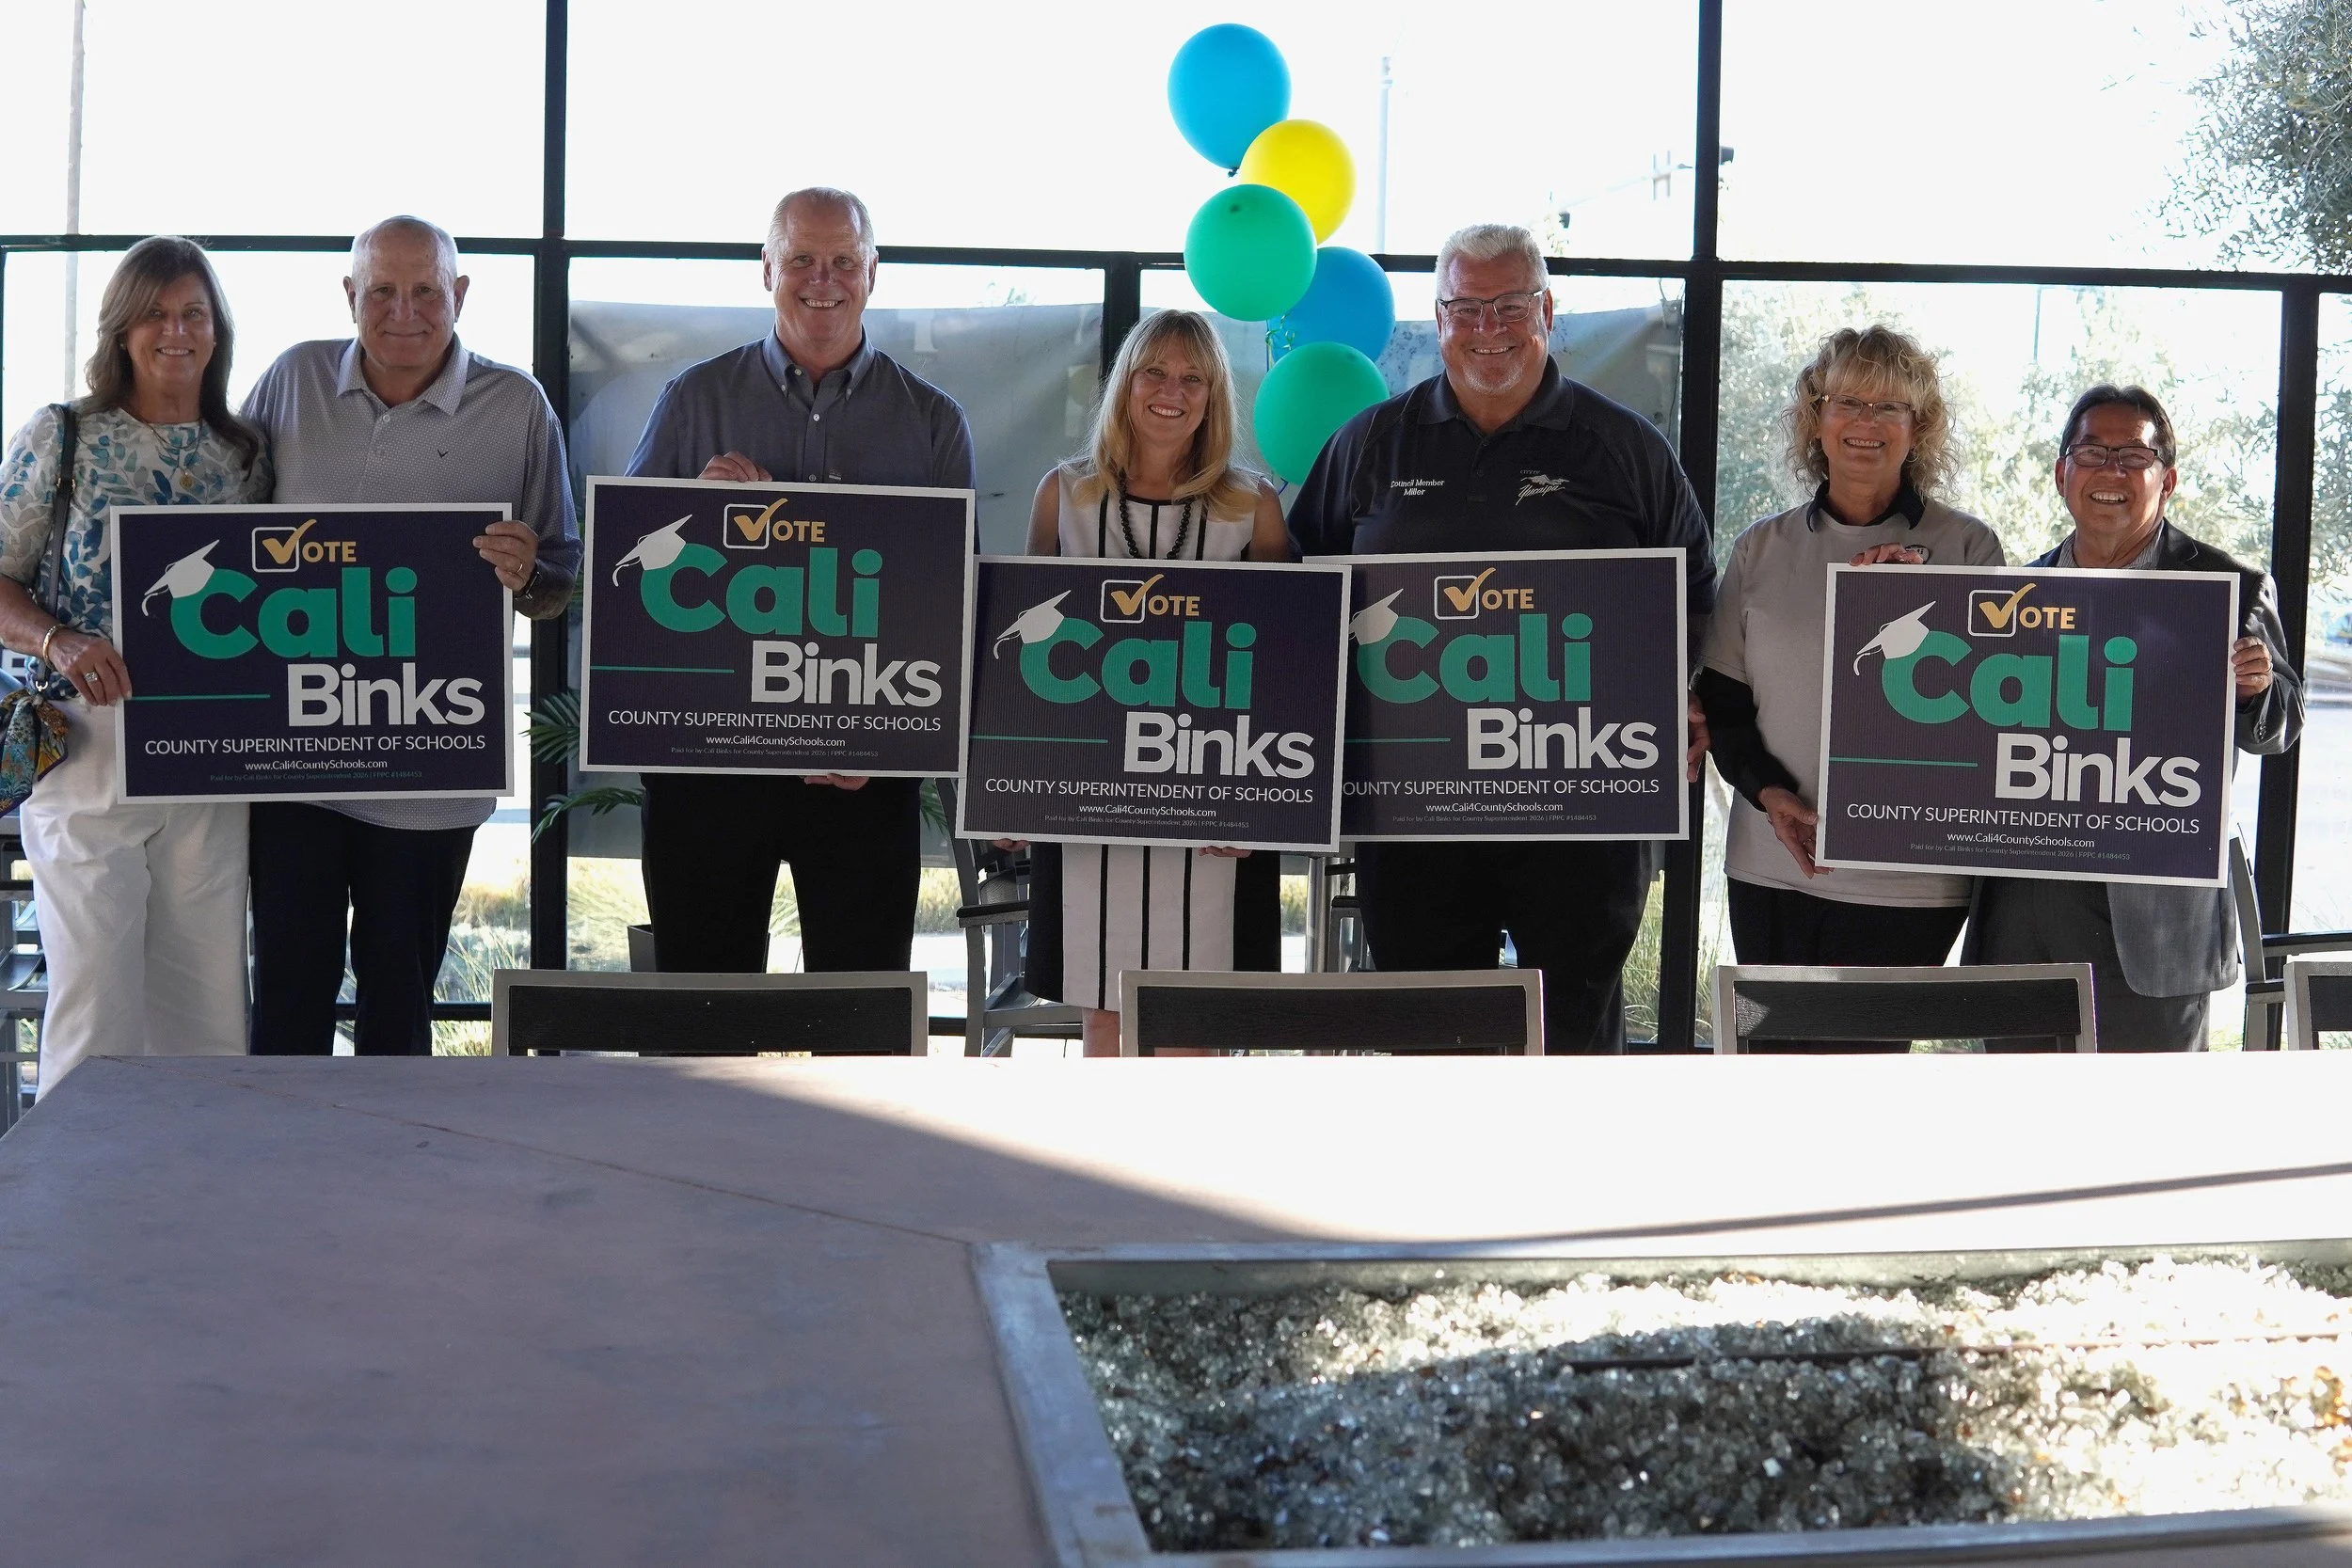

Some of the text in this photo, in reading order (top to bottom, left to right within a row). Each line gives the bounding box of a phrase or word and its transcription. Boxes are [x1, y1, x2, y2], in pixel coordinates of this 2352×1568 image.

[1391, 479, 1414, 488] Council
[1403, 487, 1426, 496] Miller
[262, 519, 356, 564] VOTE
[734, 498, 824, 543] VOTE
[641, 543, 883, 638] Cali
[1111, 574, 1200, 617] VOTE
[1444, 567, 1534, 612] VOTE
[1979, 583, 2074, 630] VOTE
[170, 566, 418, 659] Cali
[751, 640, 943, 707] Binks
[1019, 617, 1257, 709] Cali
[1357, 612, 1593, 704] Cali
[1882, 630, 2137, 731] Cali
[287, 661, 485, 727] Binks
[609, 710, 942, 732] COUNTY SUPERINTENDENT OF SCHOOLS
[705, 734, 846, 749] www.Cali4CountySchools.com
[1467, 706, 1660, 770] Binks
[144, 735, 485, 754] COUNTY SUPERINTENDENT OF SCHOOLS
[244, 758, 388, 772] www.Cali4CountySchools.com
[1123, 711, 1315, 779] Binks
[985, 778, 1313, 803] COUNTY SUPERINTENDENT OF SCHOOLS
[1343, 779, 1660, 796] OUNTY SUPERINTENDENT OF SCHOOLS
[1994, 732, 2201, 807] Binks
[1078, 802, 1216, 819] www.Cali4CountySchools.com
[1425, 801, 1564, 814] www.Cali4CountySchools.com
[1847, 803, 2200, 834] COUNTY SUPERINTENDENT OF SCHOOLS
[1946, 830, 2095, 849] www.Cali4CountySchools.com
